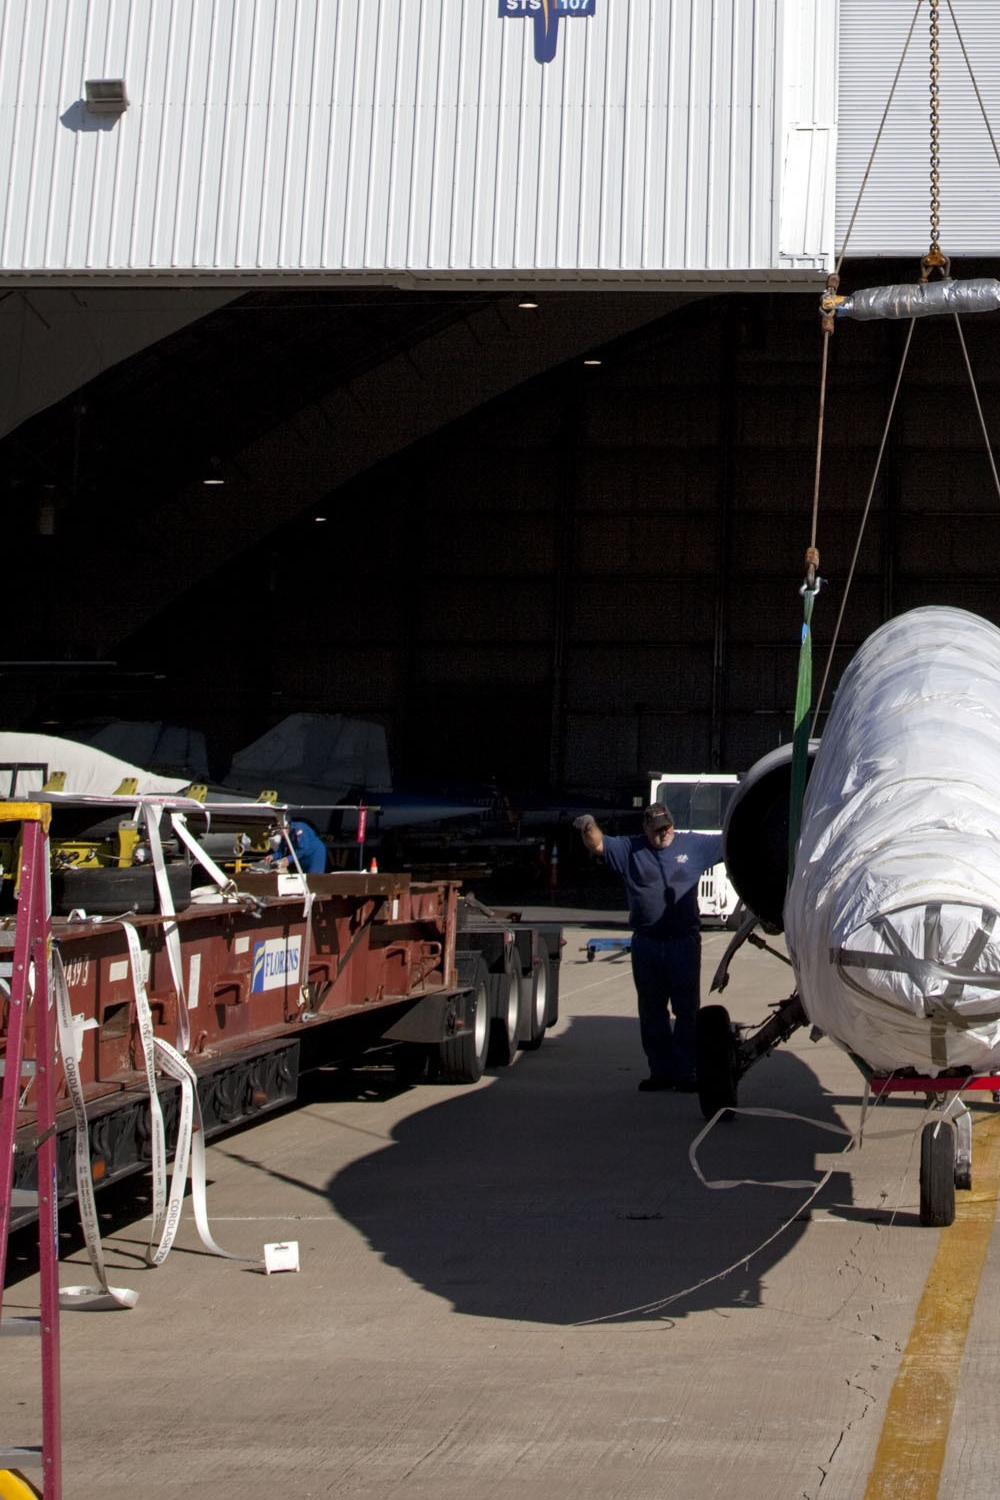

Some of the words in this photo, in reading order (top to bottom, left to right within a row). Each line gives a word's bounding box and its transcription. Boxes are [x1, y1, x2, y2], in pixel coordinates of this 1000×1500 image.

[265, 948, 299, 978] FLORENS
[142, 1023, 153, 1041] 750
[65, 1056, 83, 1110] CORDLASH
[75, 1111, 86, 1132] 750
[162, 1199, 180, 1250] CORDLASH
